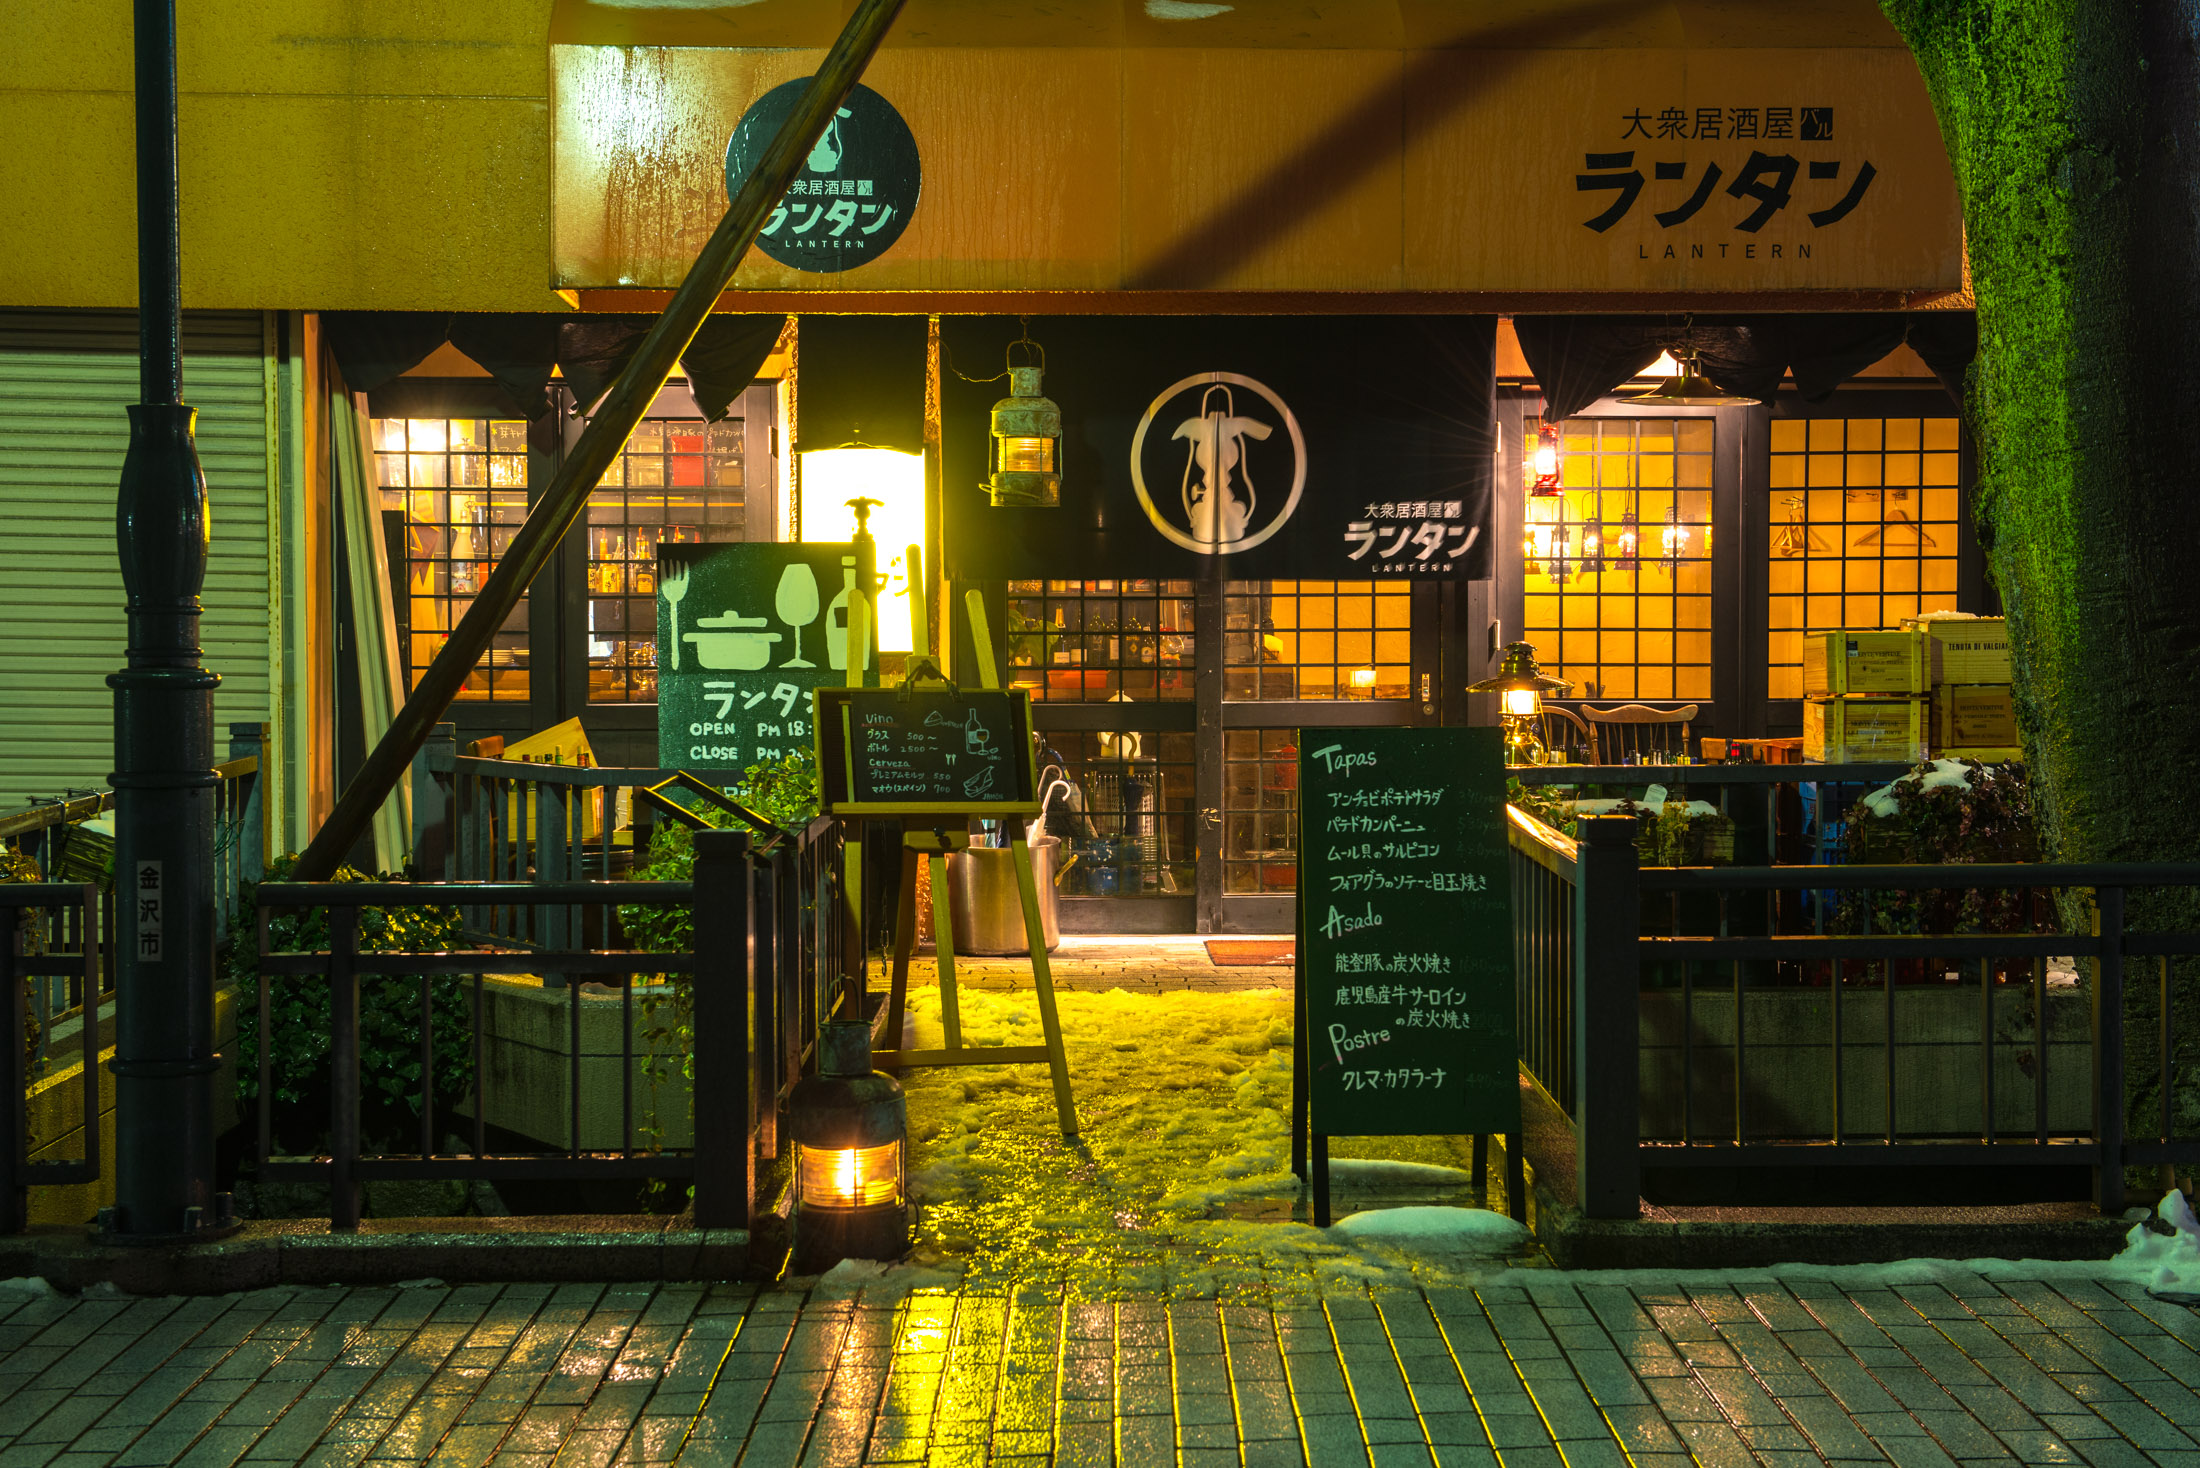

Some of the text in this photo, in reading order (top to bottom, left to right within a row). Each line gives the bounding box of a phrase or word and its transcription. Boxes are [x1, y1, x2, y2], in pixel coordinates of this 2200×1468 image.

[1575, 150, 1877, 234] ランタン
[785, 239, 864, 248] LANTERN
[1639, 243, 1812, 259] LANTERN
[1344, 519, 1481, 561] ランタン
[1371, 562, 1454, 573] LANTERN
[1948, 643, 1972, 651] TENUTA
[865, 713, 894, 724] Vino
[689, 720, 813, 738] OPEN PM 18:
[867, 728, 891, 741] グラス
[689, 745, 738, 760] CLOSE
[756, 746, 781, 760] PM
[867, 742, 890, 753] ボトル
[869, 758, 912, 768] Cerveza
[1311, 743, 1377, 778] Tapas
[870, 768, 952, 780] プレミアムモルツ 550
[933, 784, 952, 794] 700
[1327, 787, 1445, 808] アンチョビポテトサラダ
[1326, 814, 1426, 833] パテドカンパーニュ
[1327, 841, 1440, 861] ムール貝のサルピコン
[1328, 868, 1488, 893] フォアグラのソテーと目玉焼き
[139, 865, 160, 957] 金沢市
[1319, 901, 1383, 940] Asado
[1335, 951, 1451, 974] 能登豚の炭火焼き
[1334, 984, 1467, 1006] 鹿児島産牛サーロイン
[1395, 1007, 1471, 1030] の炭火焼き
[1328, 1022, 1391, 1066] Postre
